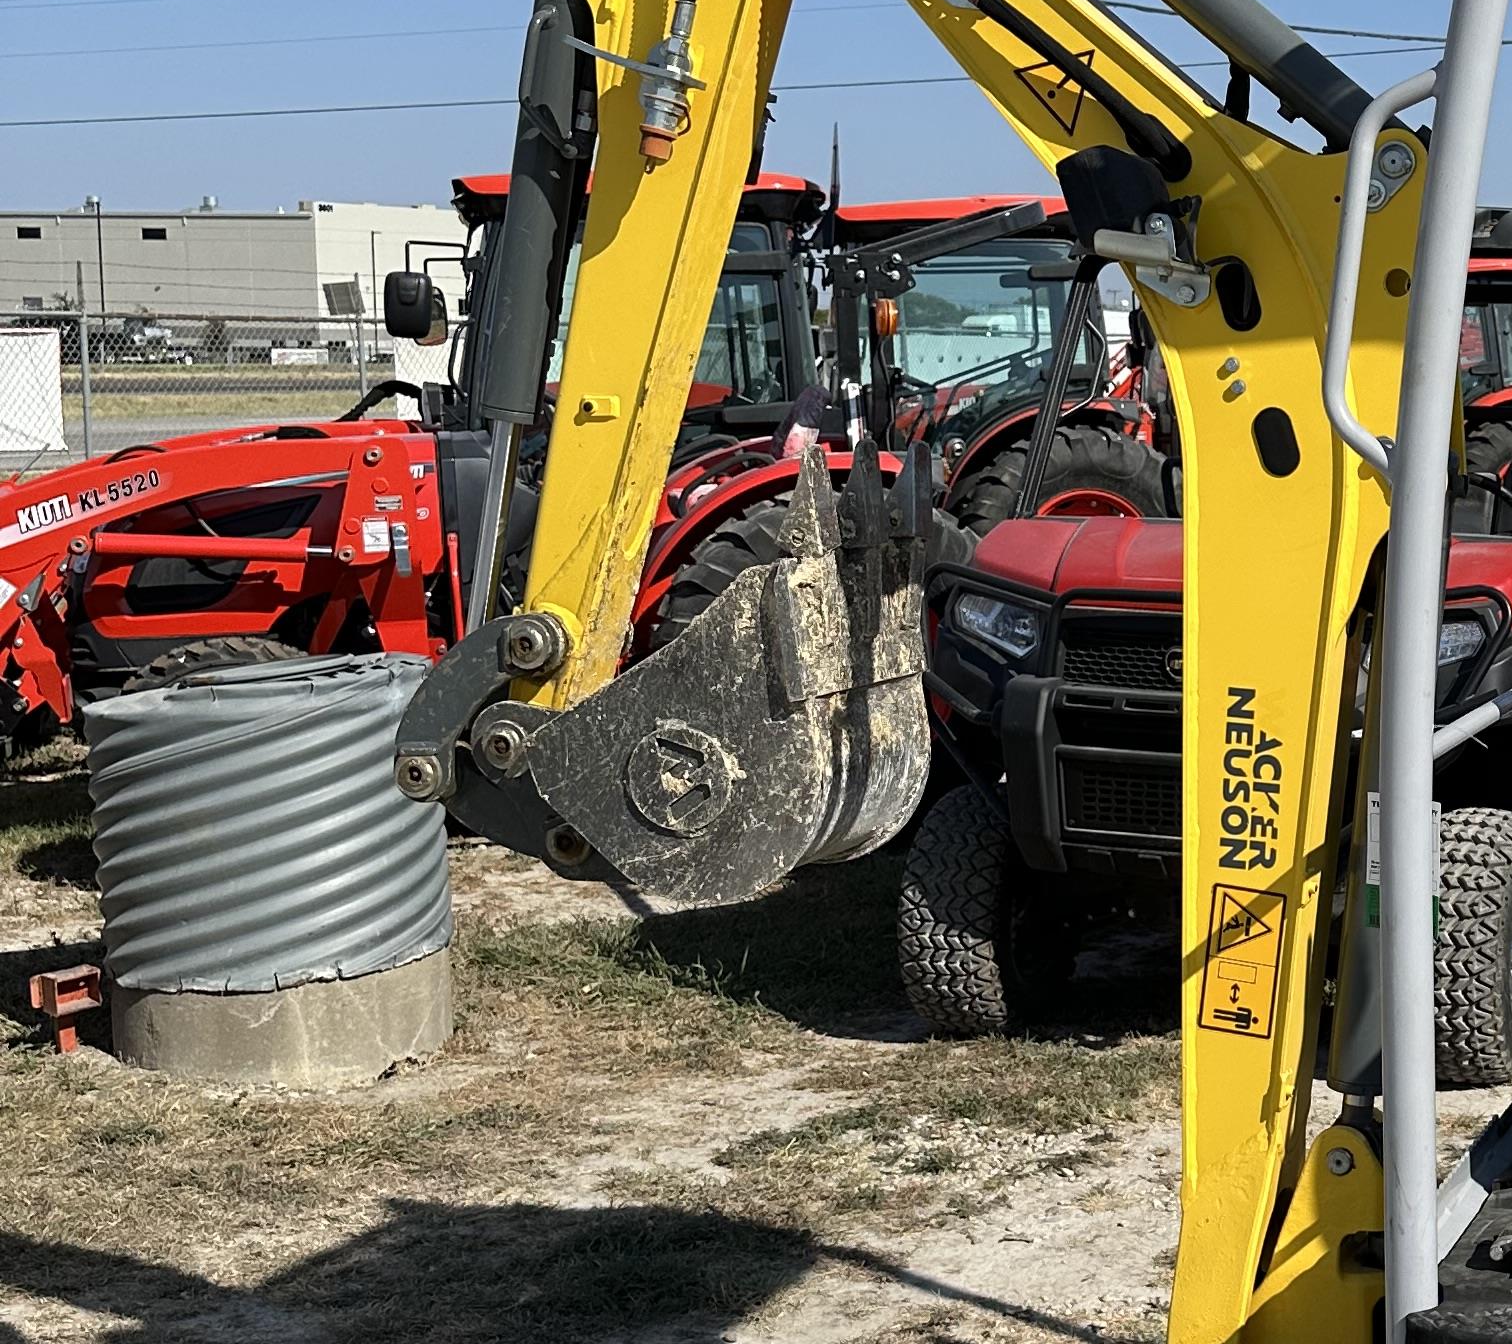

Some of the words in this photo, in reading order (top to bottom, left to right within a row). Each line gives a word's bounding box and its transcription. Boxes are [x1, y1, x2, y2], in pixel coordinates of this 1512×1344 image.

[16, 492, 73, 534] KIOTI
[79, 469, 160, 512] KL5520
[1218, 686, 1256, 870] NEUSON
